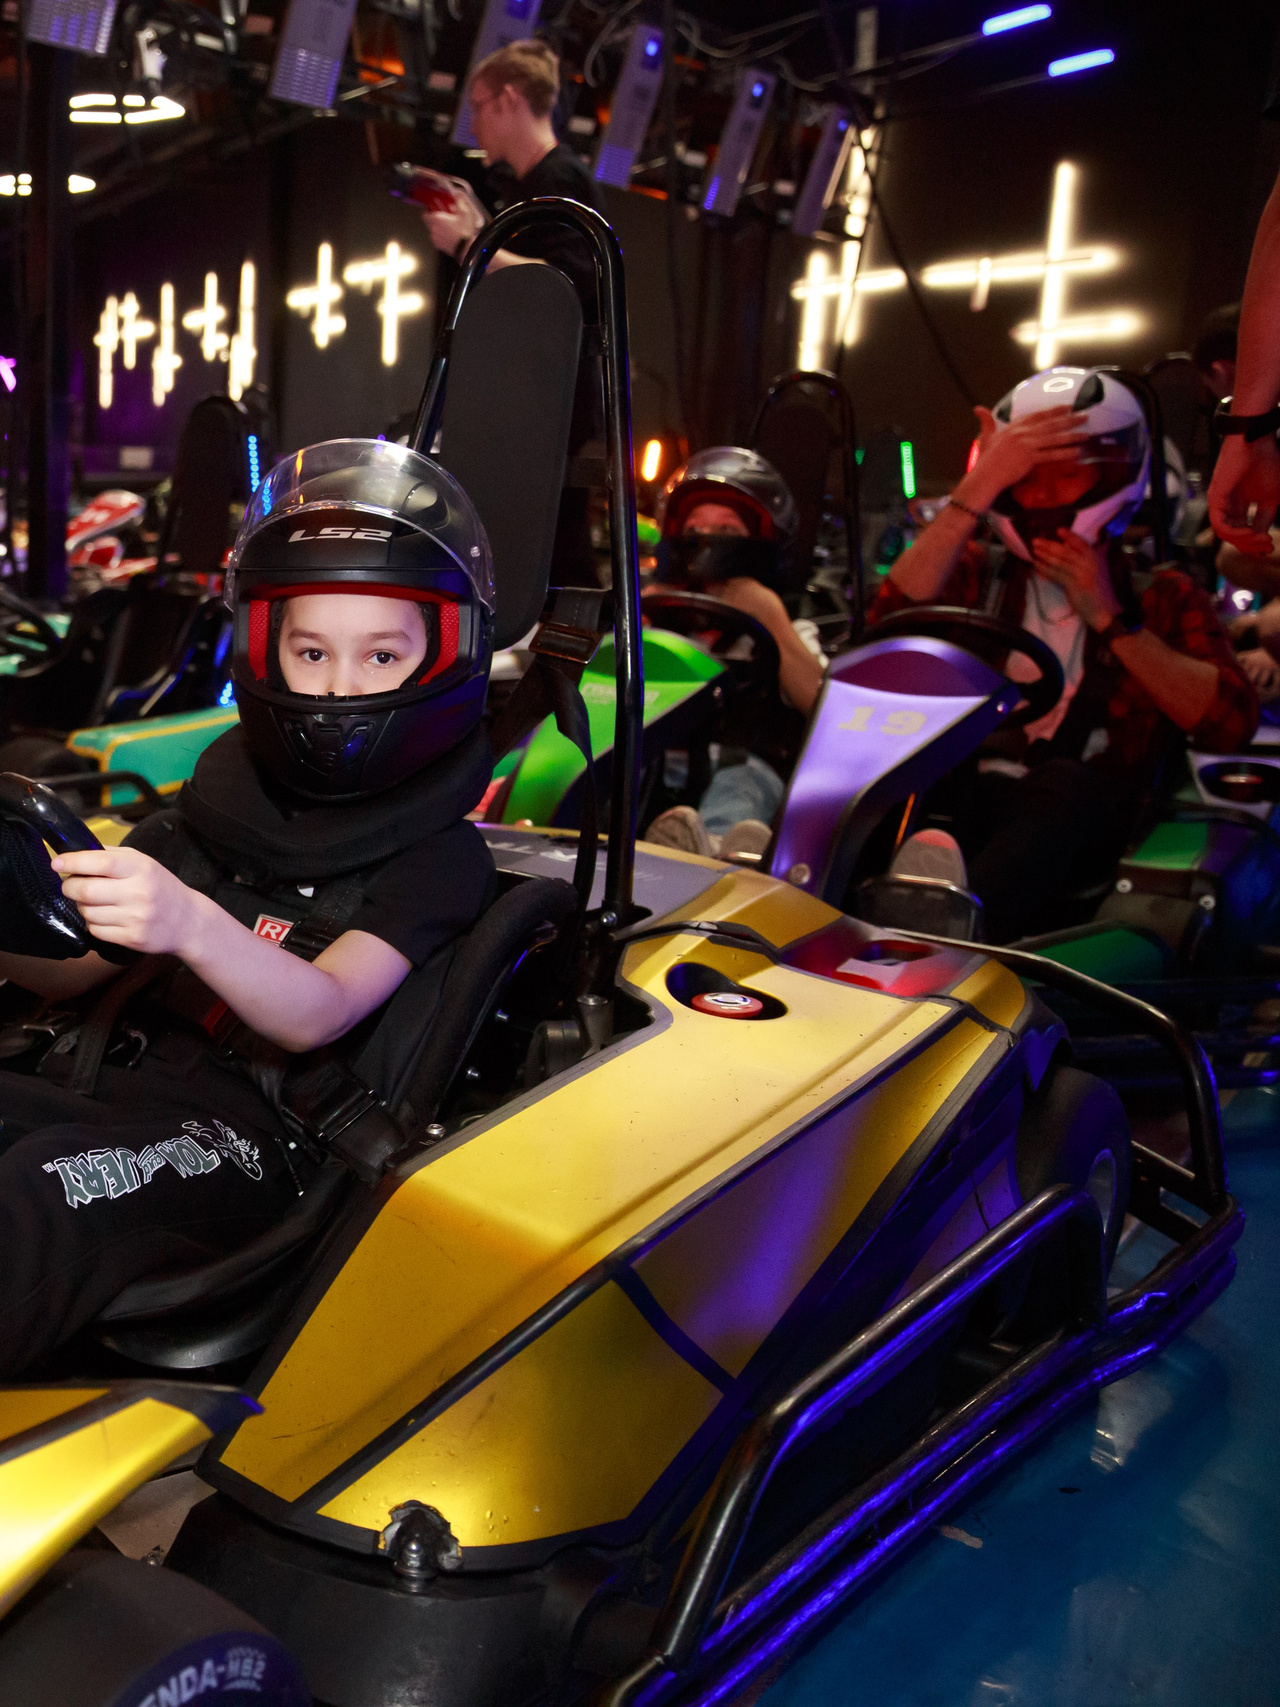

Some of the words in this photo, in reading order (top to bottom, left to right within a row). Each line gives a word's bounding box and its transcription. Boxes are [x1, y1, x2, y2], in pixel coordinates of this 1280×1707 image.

[288, 527, 393, 543] LS2
[838, 706, 927, 736] 19
[155, 1135, 221, 1178] TOM
